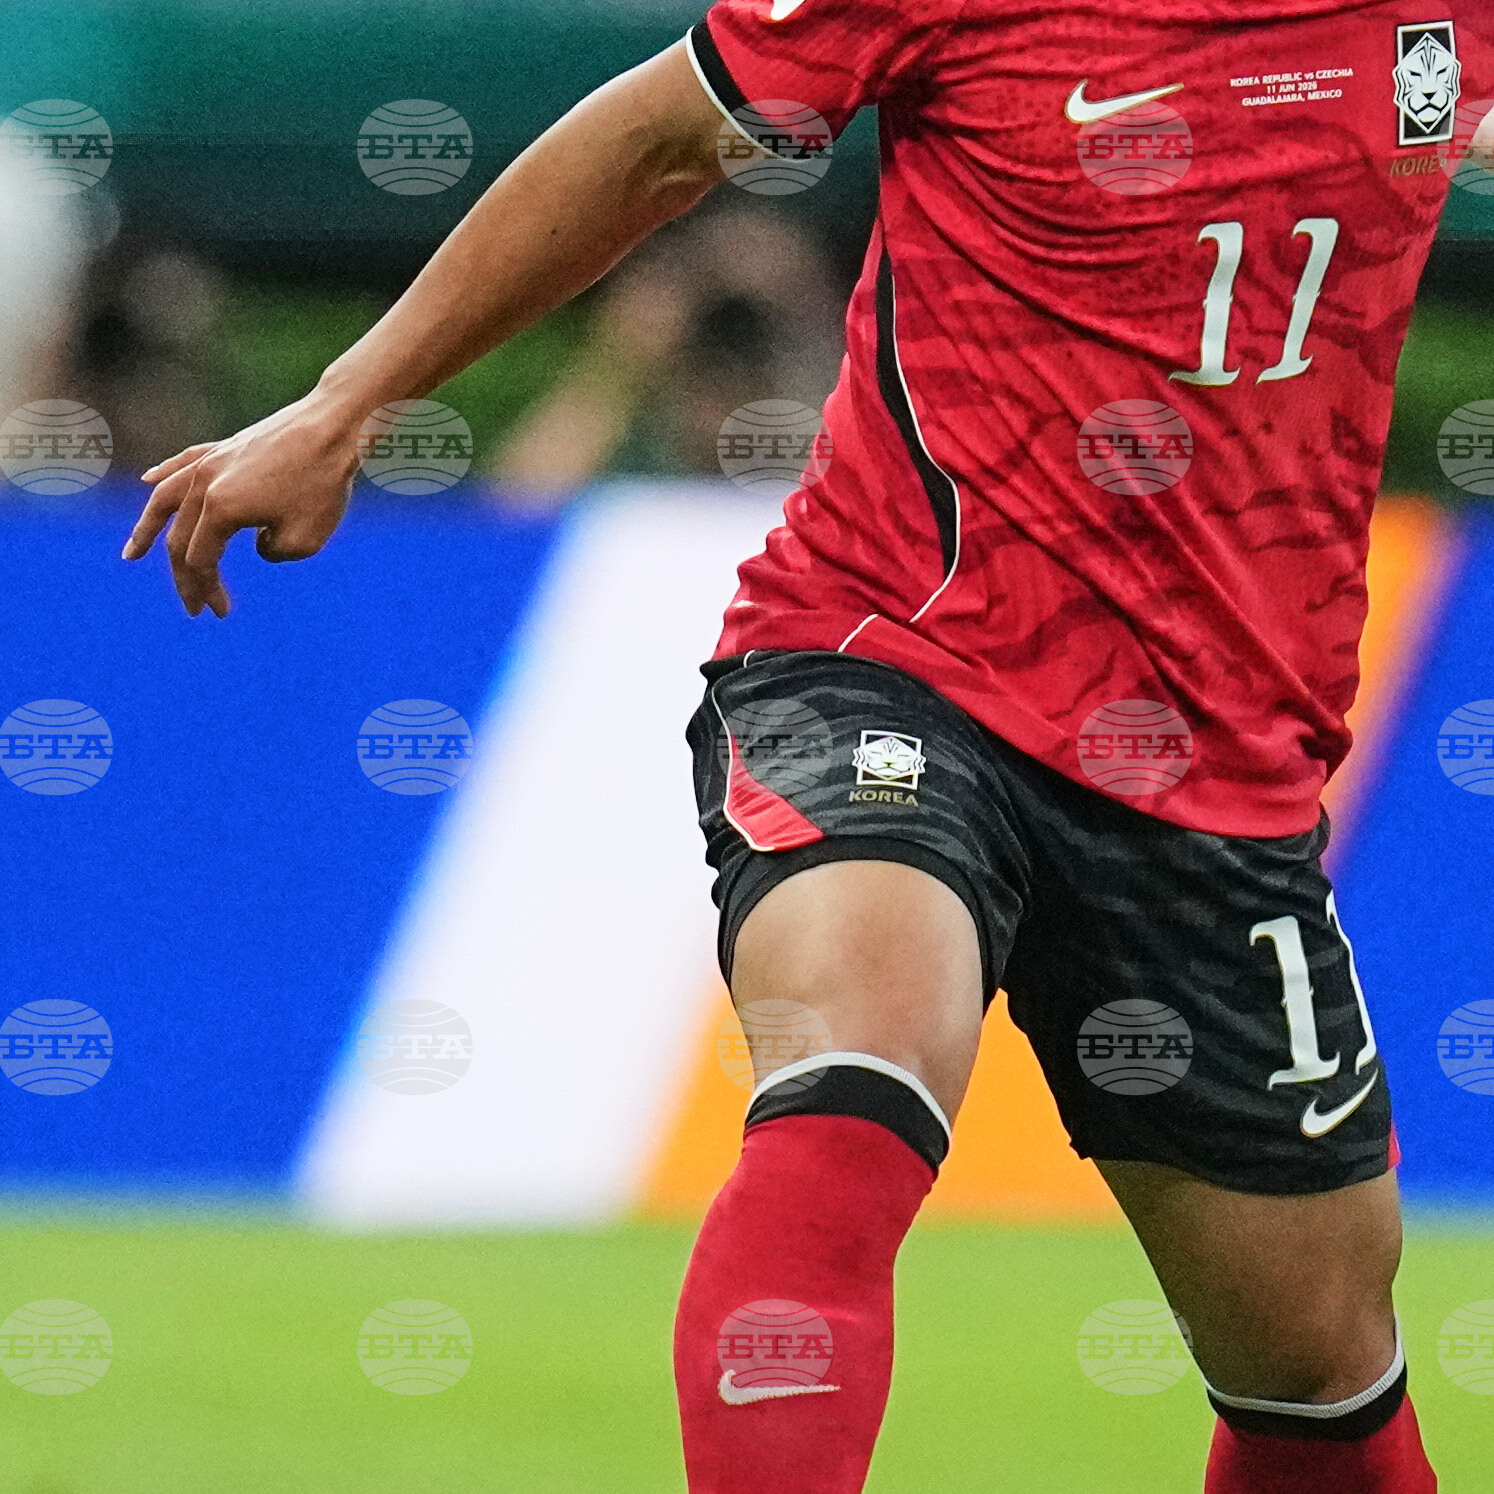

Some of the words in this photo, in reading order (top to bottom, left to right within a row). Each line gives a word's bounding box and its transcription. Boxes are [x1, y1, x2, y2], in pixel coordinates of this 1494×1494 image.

[1230, 76, 1260, 87] KOREA
[1262, 72, 1302, 84] REPUBLIC
[1315, 68, 1353, 80] CZECHIA
[1266, 85, 1276, 94] 11
[1279, 83, 1295, 93] JUN
[1297, 81, 1318, 91] 2026
[1242, 93, 1305, 106] GUADALAJARA,
[1307, 89, 1342, 101] MEXICO
[1167, 217, 1340, 386] 11
[848, 789, 919, 807] KOREA
